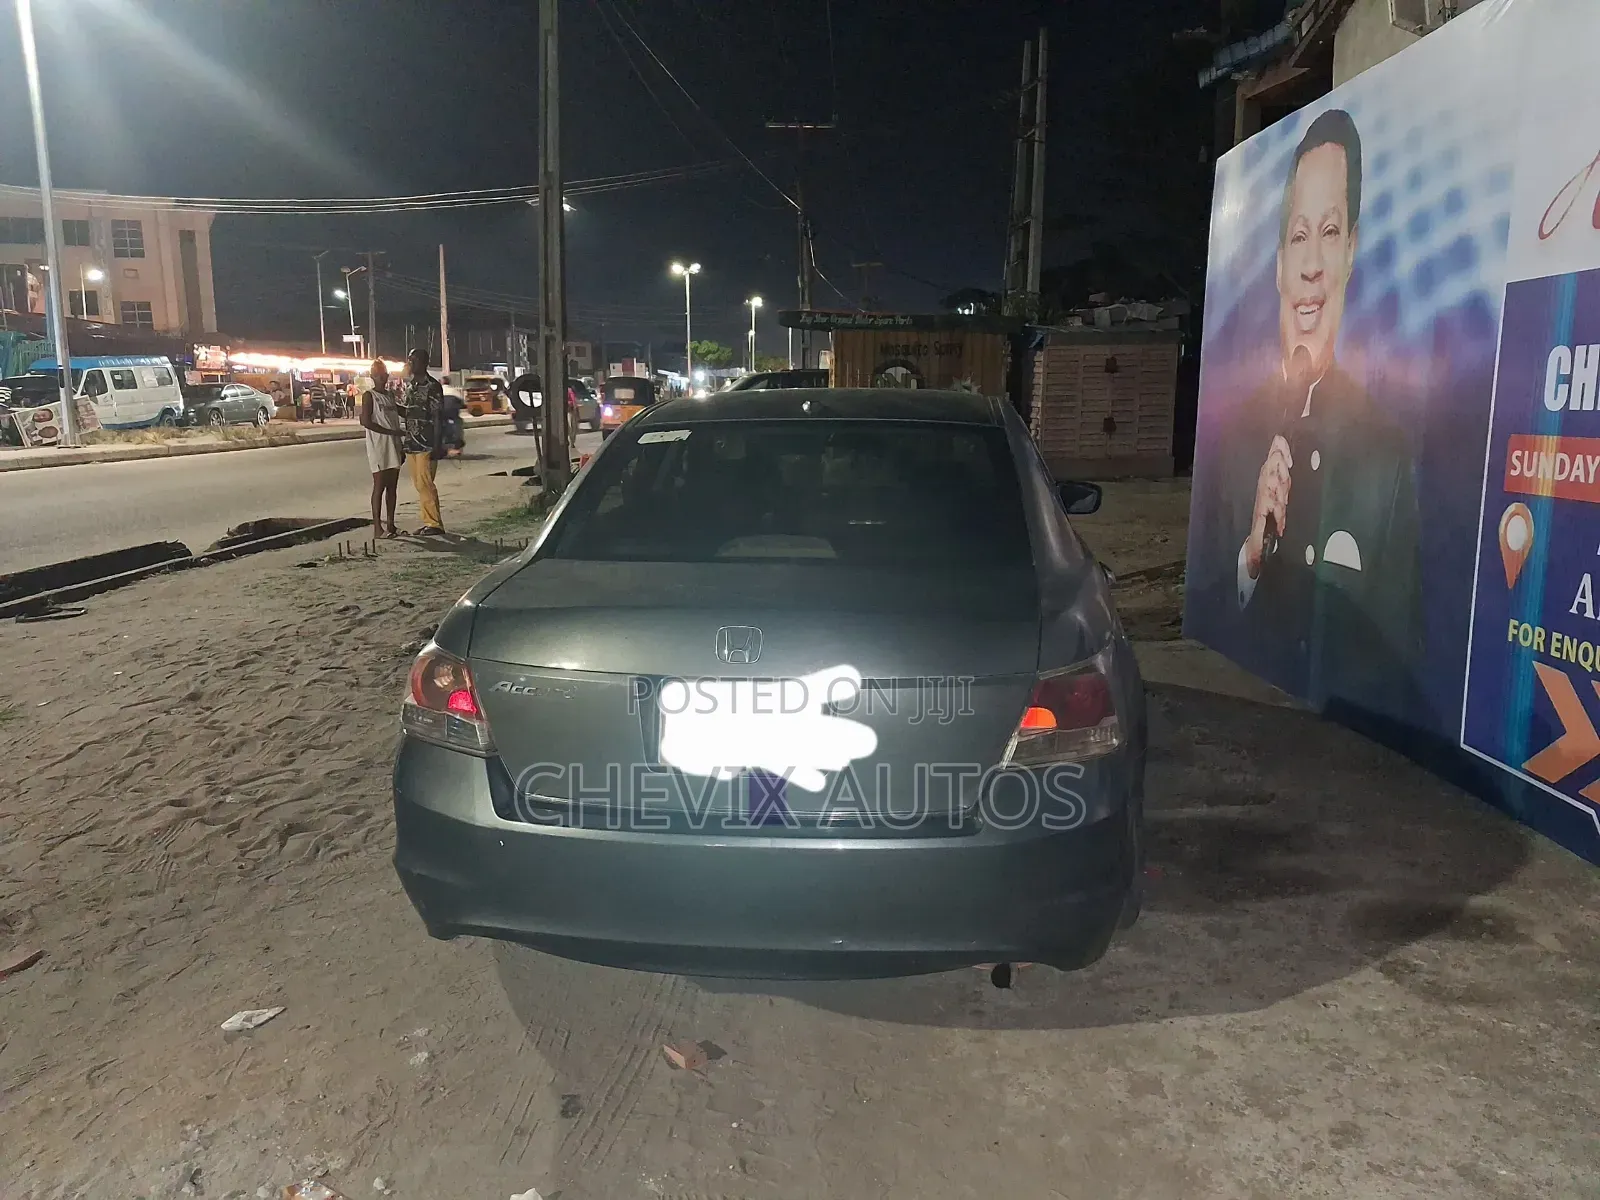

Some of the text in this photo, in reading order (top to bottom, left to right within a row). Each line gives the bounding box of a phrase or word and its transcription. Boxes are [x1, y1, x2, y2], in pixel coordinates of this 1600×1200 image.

[1544, 344, 1600, 412] CH
[1510, 450, 1600, 484] SUNDAY
[1569, 572, 1600, 621] A
[1508, 618, 1546, 652] FOR
